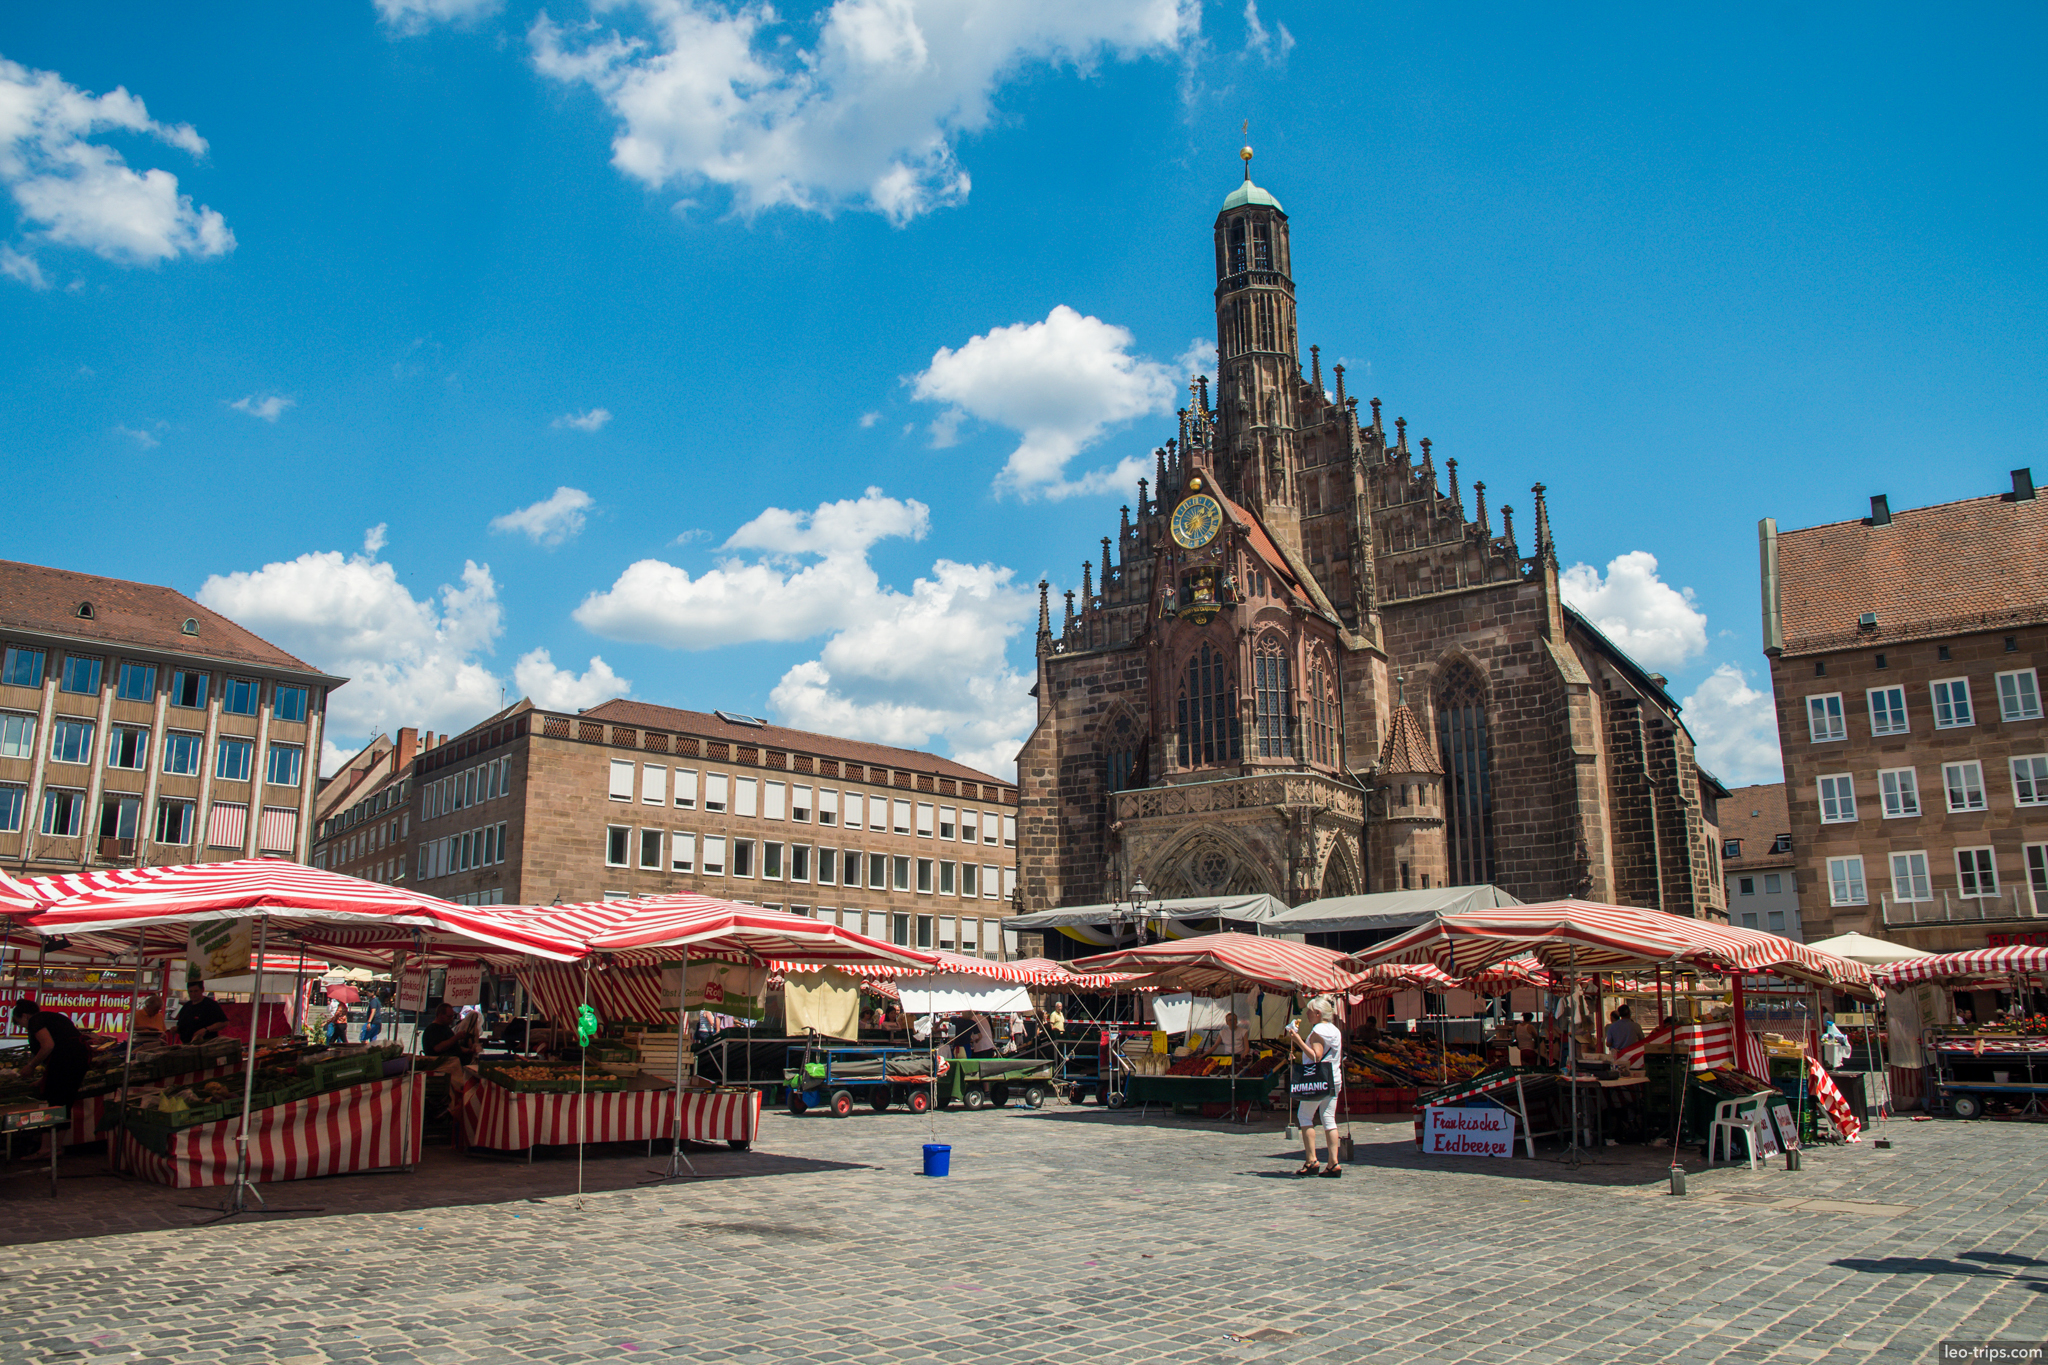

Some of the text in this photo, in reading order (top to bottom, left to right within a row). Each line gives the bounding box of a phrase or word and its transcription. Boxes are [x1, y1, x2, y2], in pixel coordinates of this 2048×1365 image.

[1986, 932, 2048, 948] BLOC
[447, 974, 480, 986] Fränkischer
[451, 986, 474, 999] Spargel
[40, 993, 130, 1010] Türkischer Honig
[1290, 1081, 1328, 1093] HUMANIC
[1433, 1133, 1507, 1154] Erdbeeren
